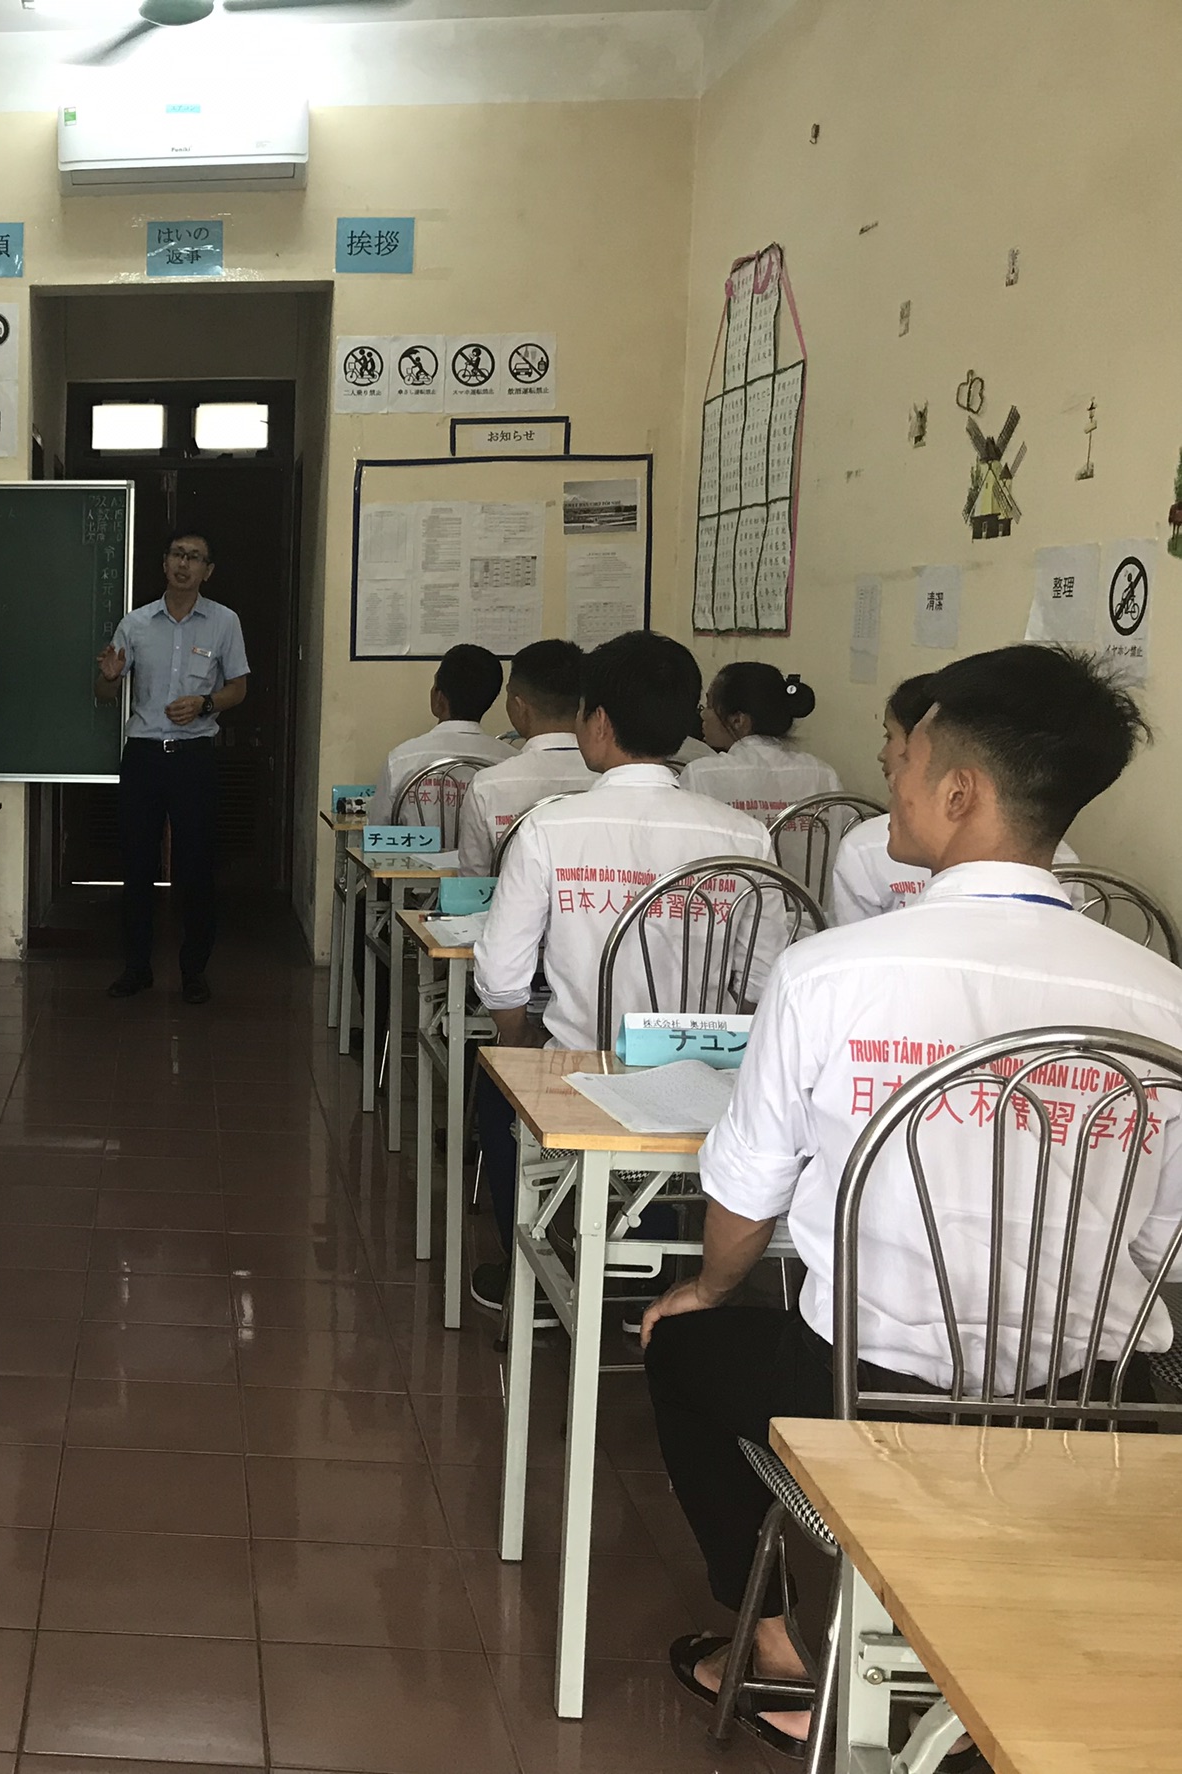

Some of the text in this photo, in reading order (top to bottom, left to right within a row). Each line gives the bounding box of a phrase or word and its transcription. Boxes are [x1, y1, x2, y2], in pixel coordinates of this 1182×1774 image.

[157, 227, 210, 244] はいの
[347, 230, 400, 257] 挨拶
[166, 249, 202, 266] 返事
[487, 430, 535, 442] お知らせ
[1052, 576, 1075, 599] 整理
[368, 833, 433, 848] チュオン
[580, 865, 597, 882] TÂM
[599, 865, 616, 883] ĐÀO
[617, 869, 633, 886] TẠO
[718, 873, 736, 893] BẢN
[889, 880, 917, 894] TRUNG
[848, 1039, 889, 1063] TRUNG
[892, 1036, 923, 1066] TÂM
[1070, 1066, 1101, 1096] LỰC
